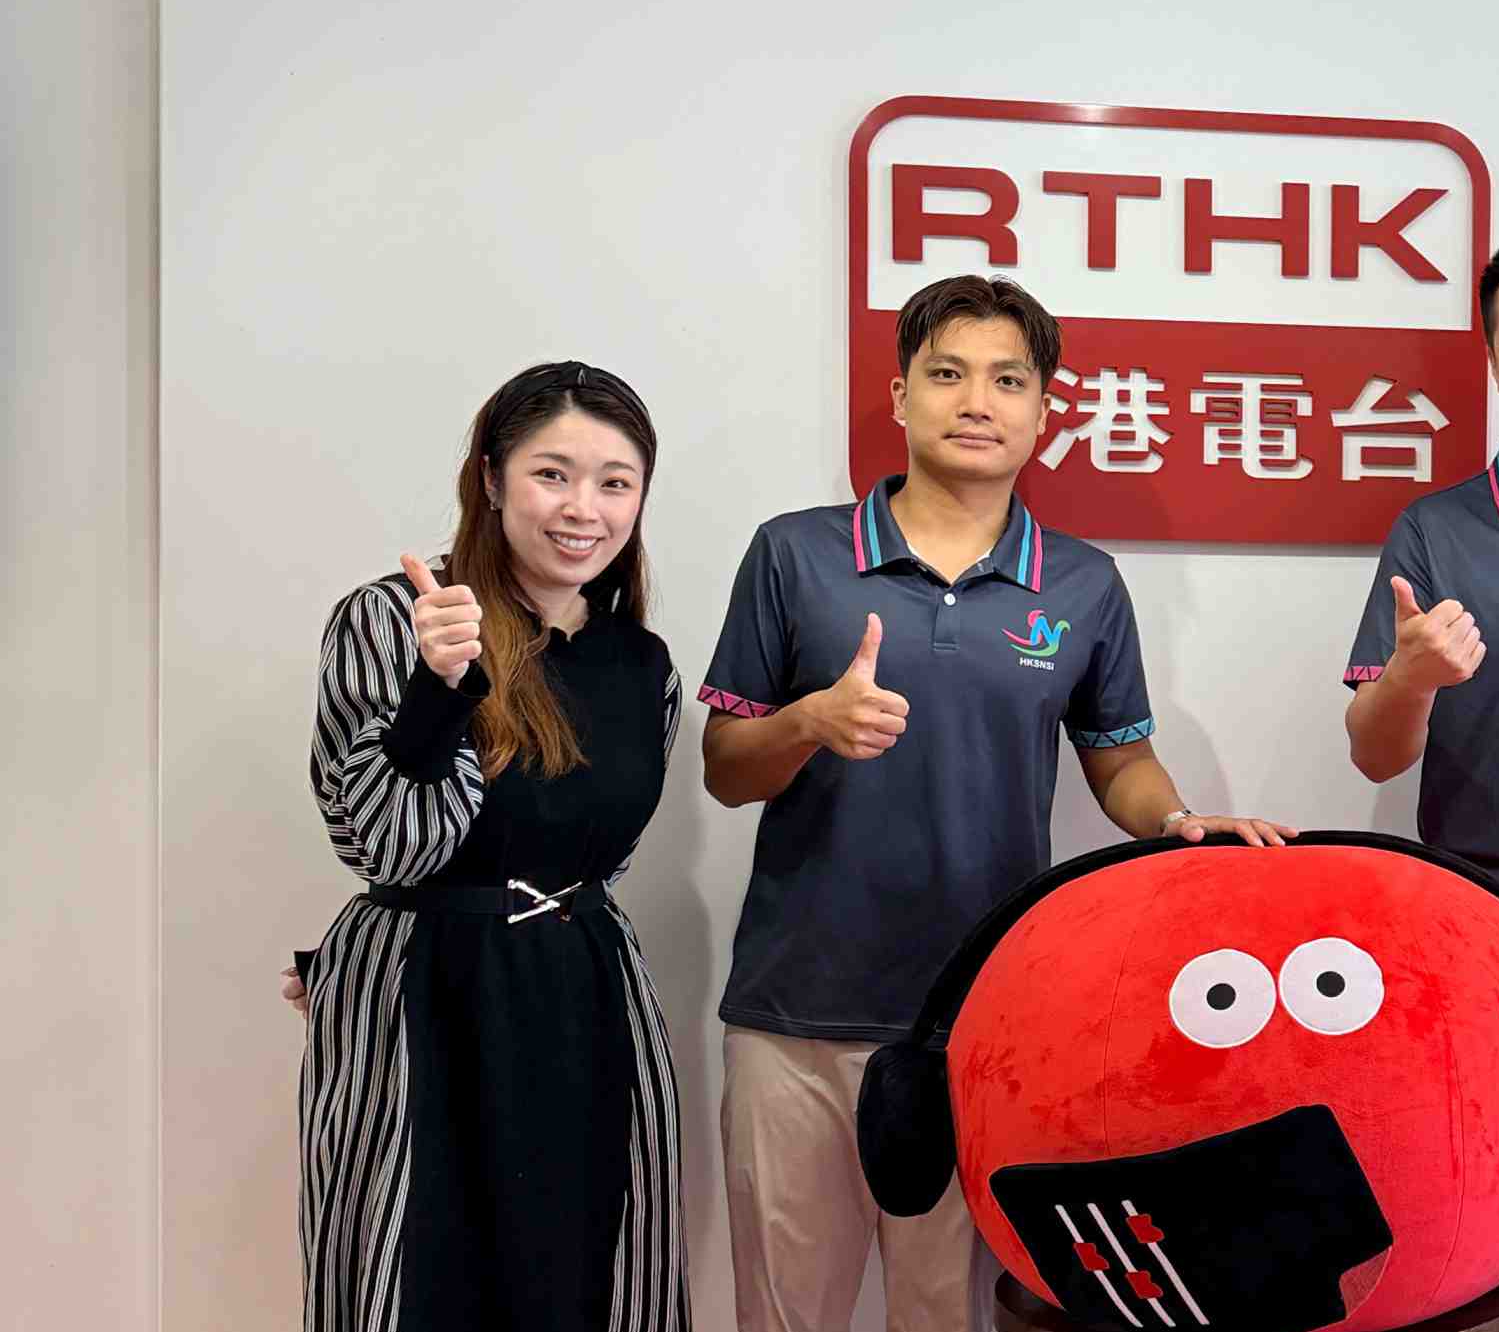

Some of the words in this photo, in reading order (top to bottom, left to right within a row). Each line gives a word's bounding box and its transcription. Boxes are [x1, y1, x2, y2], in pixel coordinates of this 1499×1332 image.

[890, 162, 1449, 284] RTHK
[893, 366, 1450, 483] 港電台
